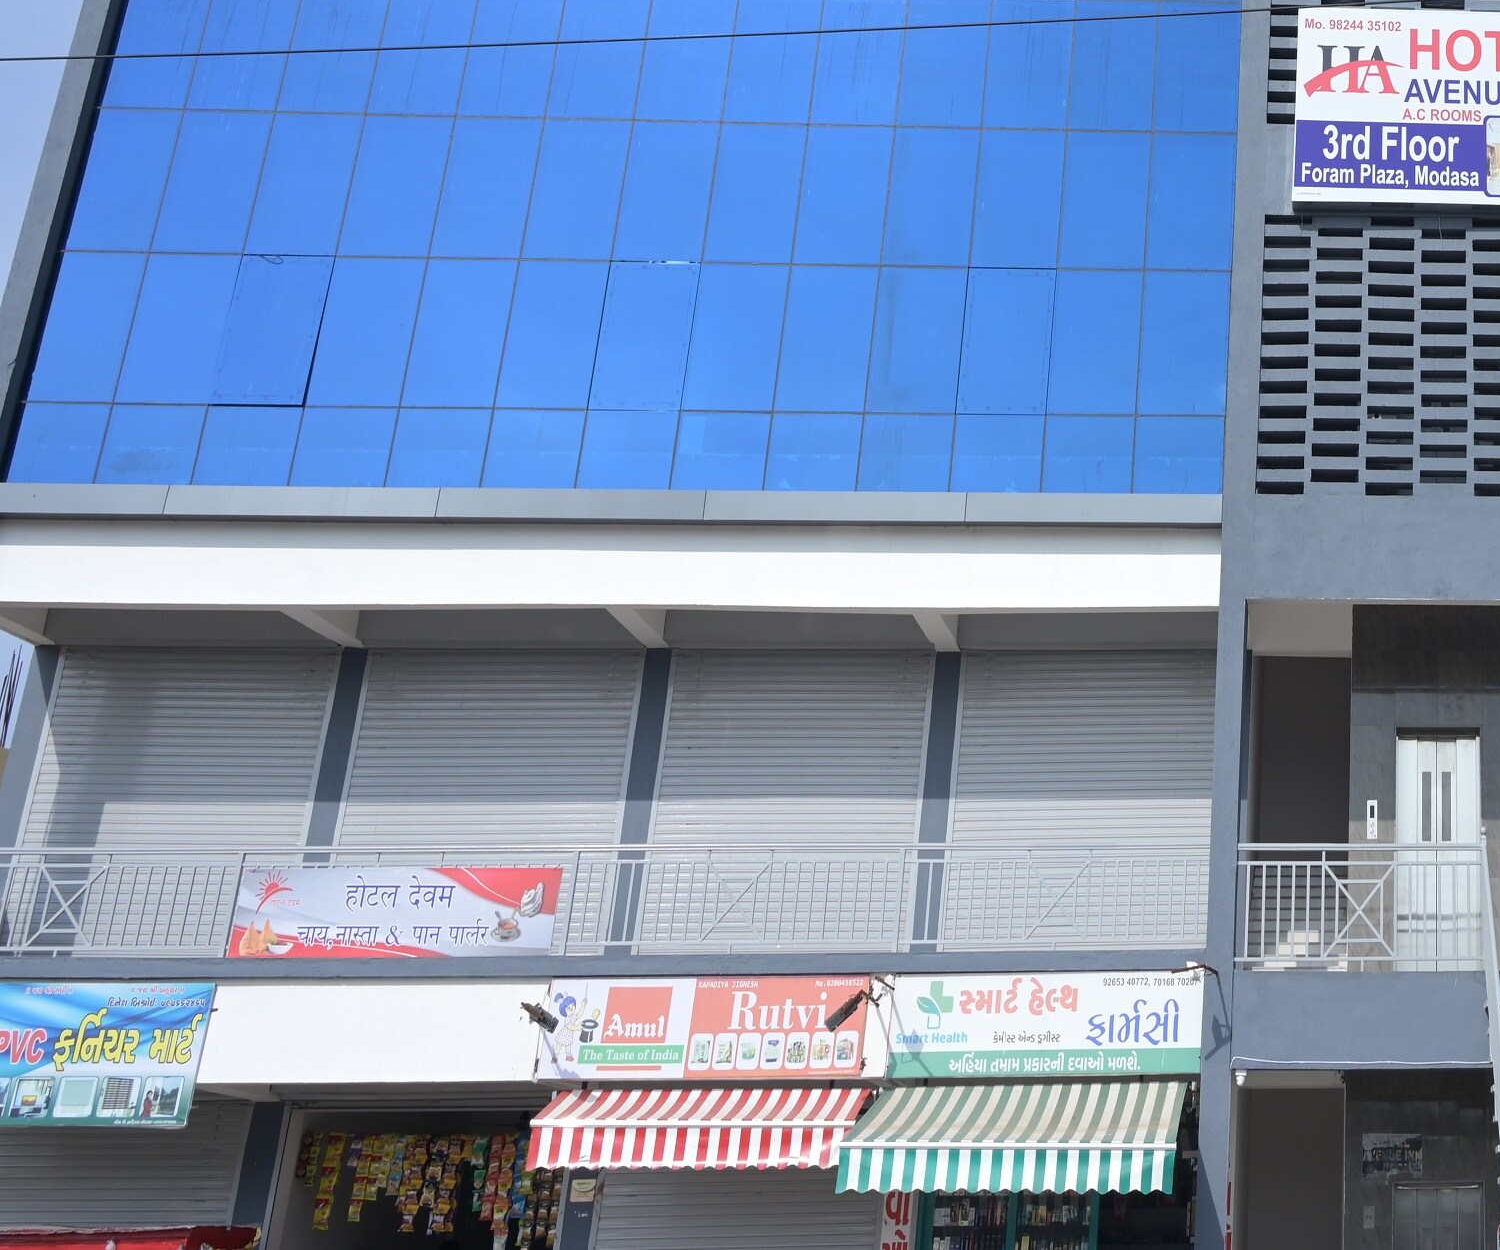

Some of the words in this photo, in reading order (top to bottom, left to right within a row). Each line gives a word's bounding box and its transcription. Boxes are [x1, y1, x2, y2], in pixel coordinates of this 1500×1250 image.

[1304, 18, 1326, 30] Mo.
[1329, 18, 1364, 31] 98244
[1367, 20, 1402, 32] 35102
[1402, 108, 1426, 121] A.C
[1430, 109, 1482, 122] ROOMS
[1323, 124, 1370, 160] 3rd
[1381, 126, 1460, 162] Floor
[1301, 162, 1354, 184] Foram
[1360, 164, 1409, 188] Plaza,
[1415, 166, 1479, 187] Modasa
[345, 875, 400, 911] होटल
[409, 875, 455, 910] देवम
[385, 927, 403, 946] &
[412, 925, 442, 946] पान
[449, 917, 489, 947] पार्लर
[959, 977, 1023, 1015] સ્માર્ટ
[1028, 976, 1079, 1016] હેલ્થ
[1103, 978, 1125, 987] 92653
[1153, 978, 1175, 986] 70168
[727, 991, 828, 1032] Rutvi
[604, 1013, 665, 1041] Amul
[895, 1032, 929, 1045] Smart
[931, 1031, 968, 1044] Health
[0, 1027, 47, 1065] PVC
[583, 1049, 603, 1060] The
[606, 1049, 635, 1061] Taste
[637, 1049, 650, 1062] of
[651, 1049, 679, 1060] India
[990, 1057, 1020, 1073] તમામ
[1023, 1052, 1064, 1072] પ્રકારની
[1067, 1051, 1104, 1071] દવાઓ
